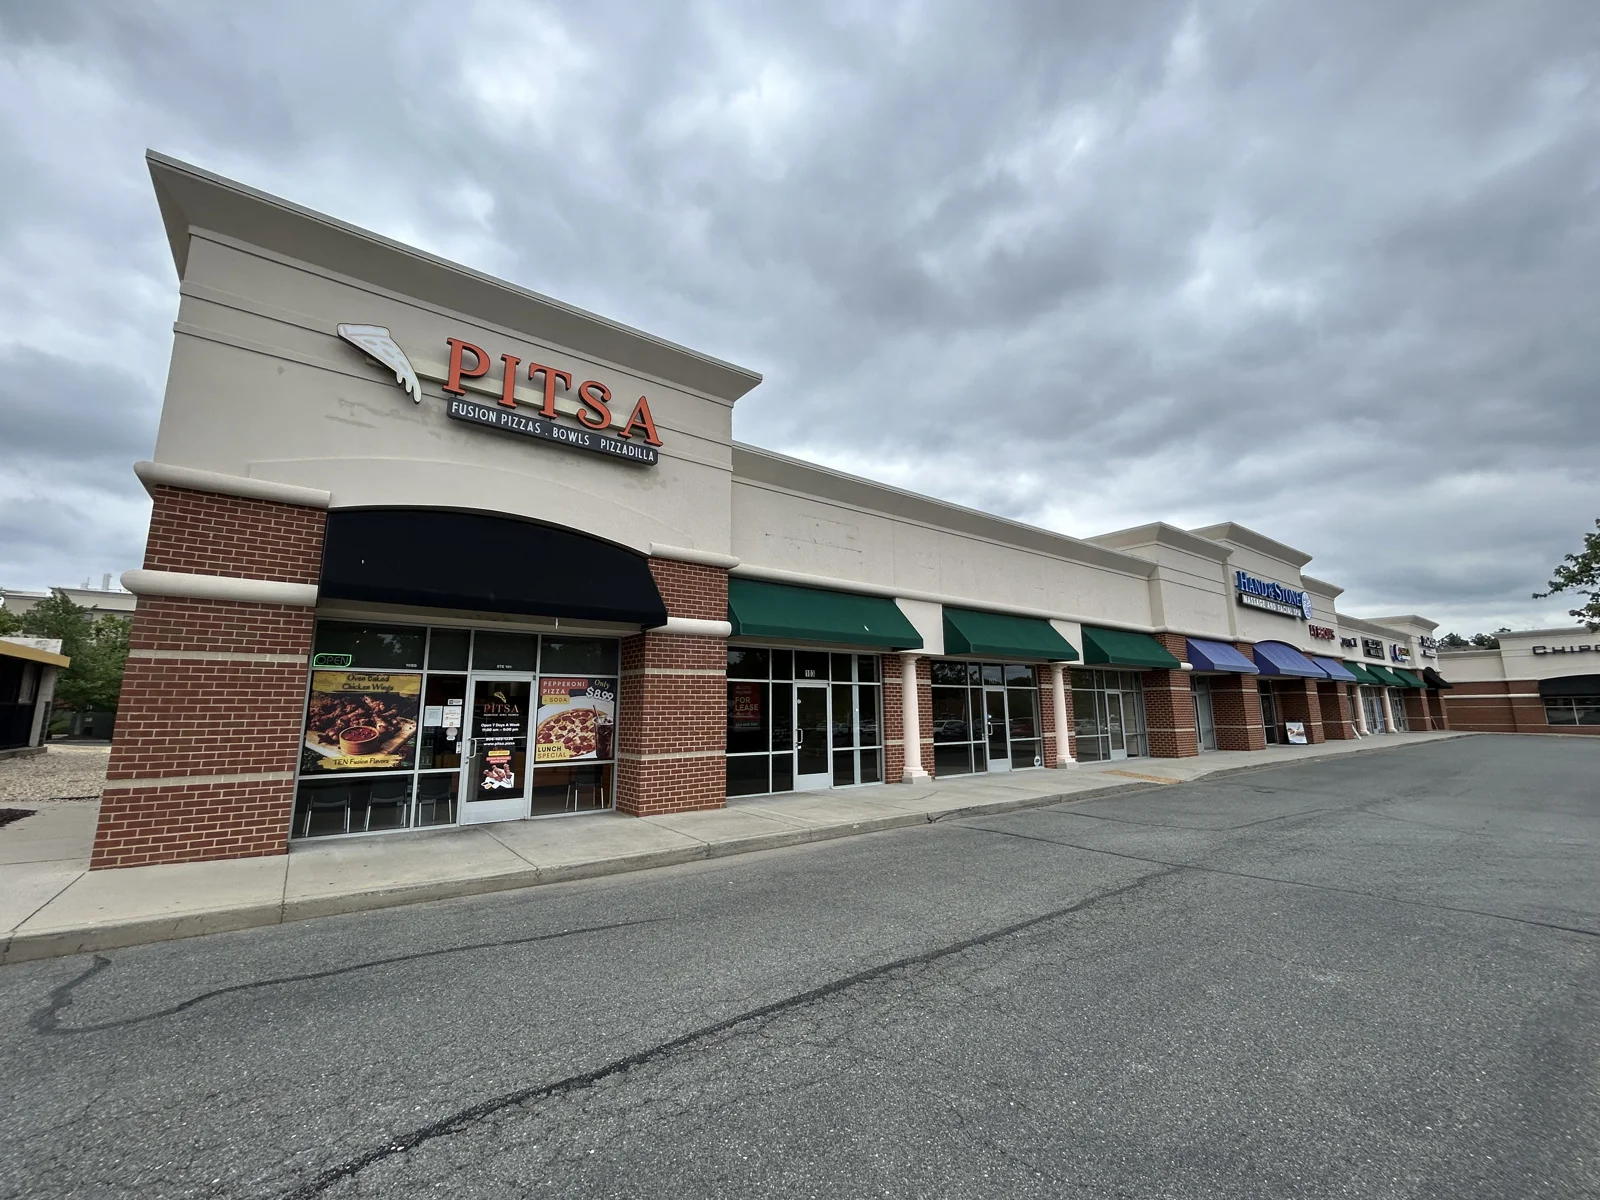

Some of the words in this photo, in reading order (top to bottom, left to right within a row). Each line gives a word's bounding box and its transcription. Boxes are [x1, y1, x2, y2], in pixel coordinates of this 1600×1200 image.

[442, 337, 663, 447] PITSA
[451, 402, 496, 423] FUSION
[501, 413, 541, 434] PIZZAS
[552, 427, 590, 446] BOWLS
[600, 438, 654, 462] PIZZADILLA
[1242, 594, 1266, 608] MASSAGE
[1267, 602, 1276, 611] AND
[316, 655, 349, 665] OPEN
[368, 674, 389, 682] Baked
[372, 684, 394, 692] Wings
[594, 679, 610, 690] Only
[585, 686, 614, 702] $8.99
[484, 703, 519, 713] PITSA
